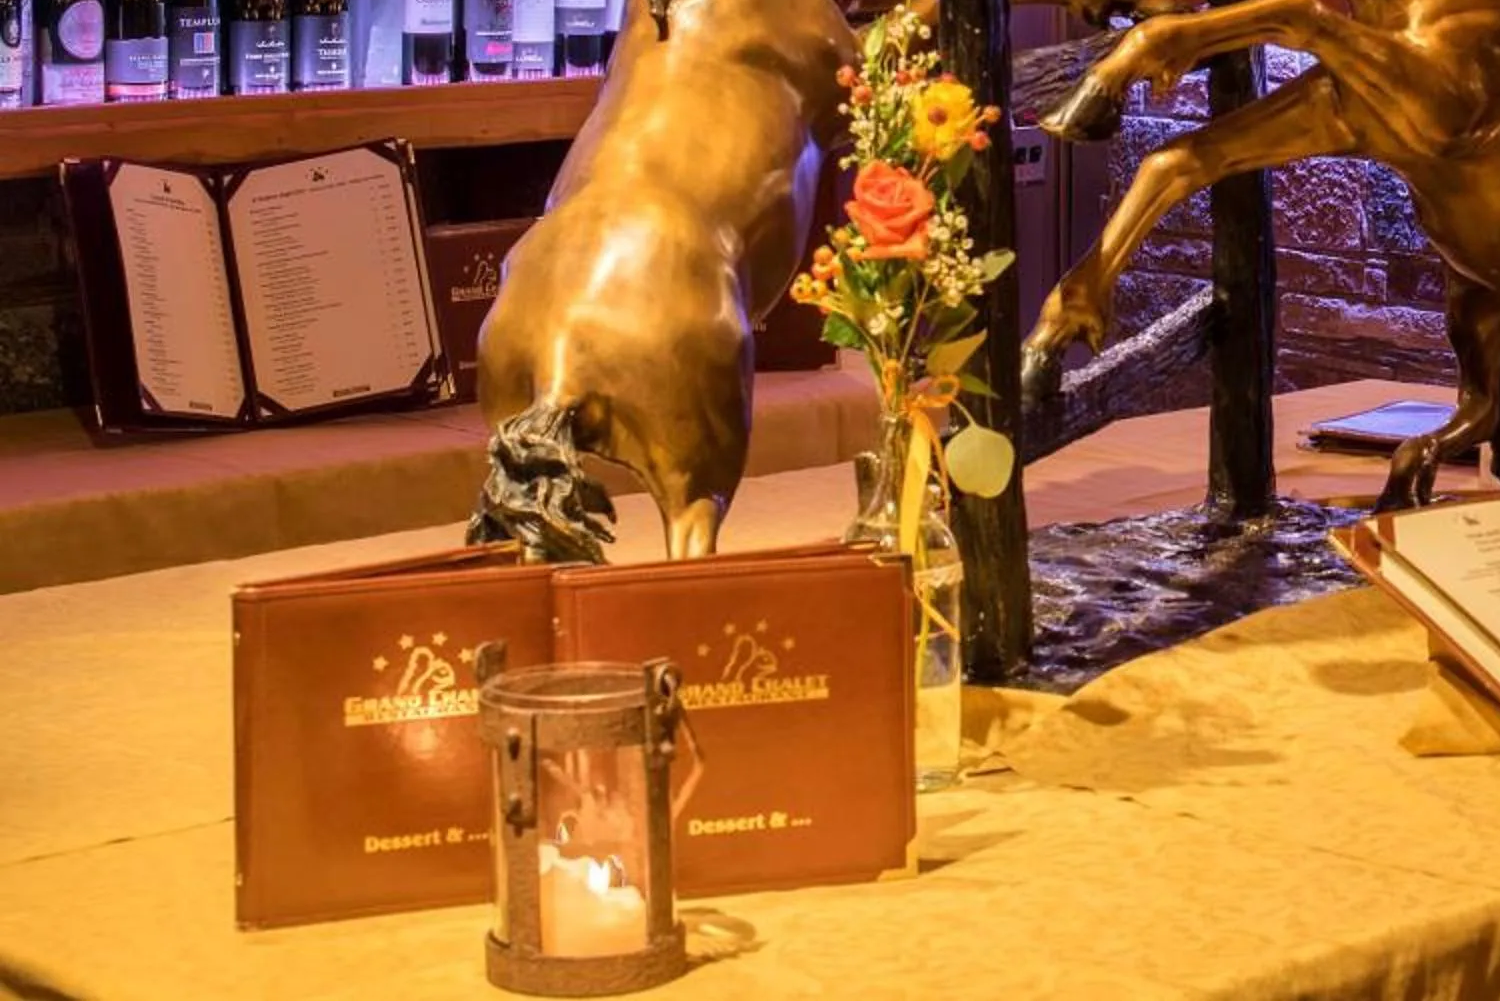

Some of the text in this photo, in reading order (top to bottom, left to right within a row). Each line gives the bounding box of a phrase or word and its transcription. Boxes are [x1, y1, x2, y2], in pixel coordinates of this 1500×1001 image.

[751, 674, 832, 696] CHALET
[344, 694, 424, 716] GRAND
[688, 813, 766, 836] Dessert
[769, 811, 788, 829] &
[364, 829, 441, 854] Dessert
[446, 827, 464, 843] &
